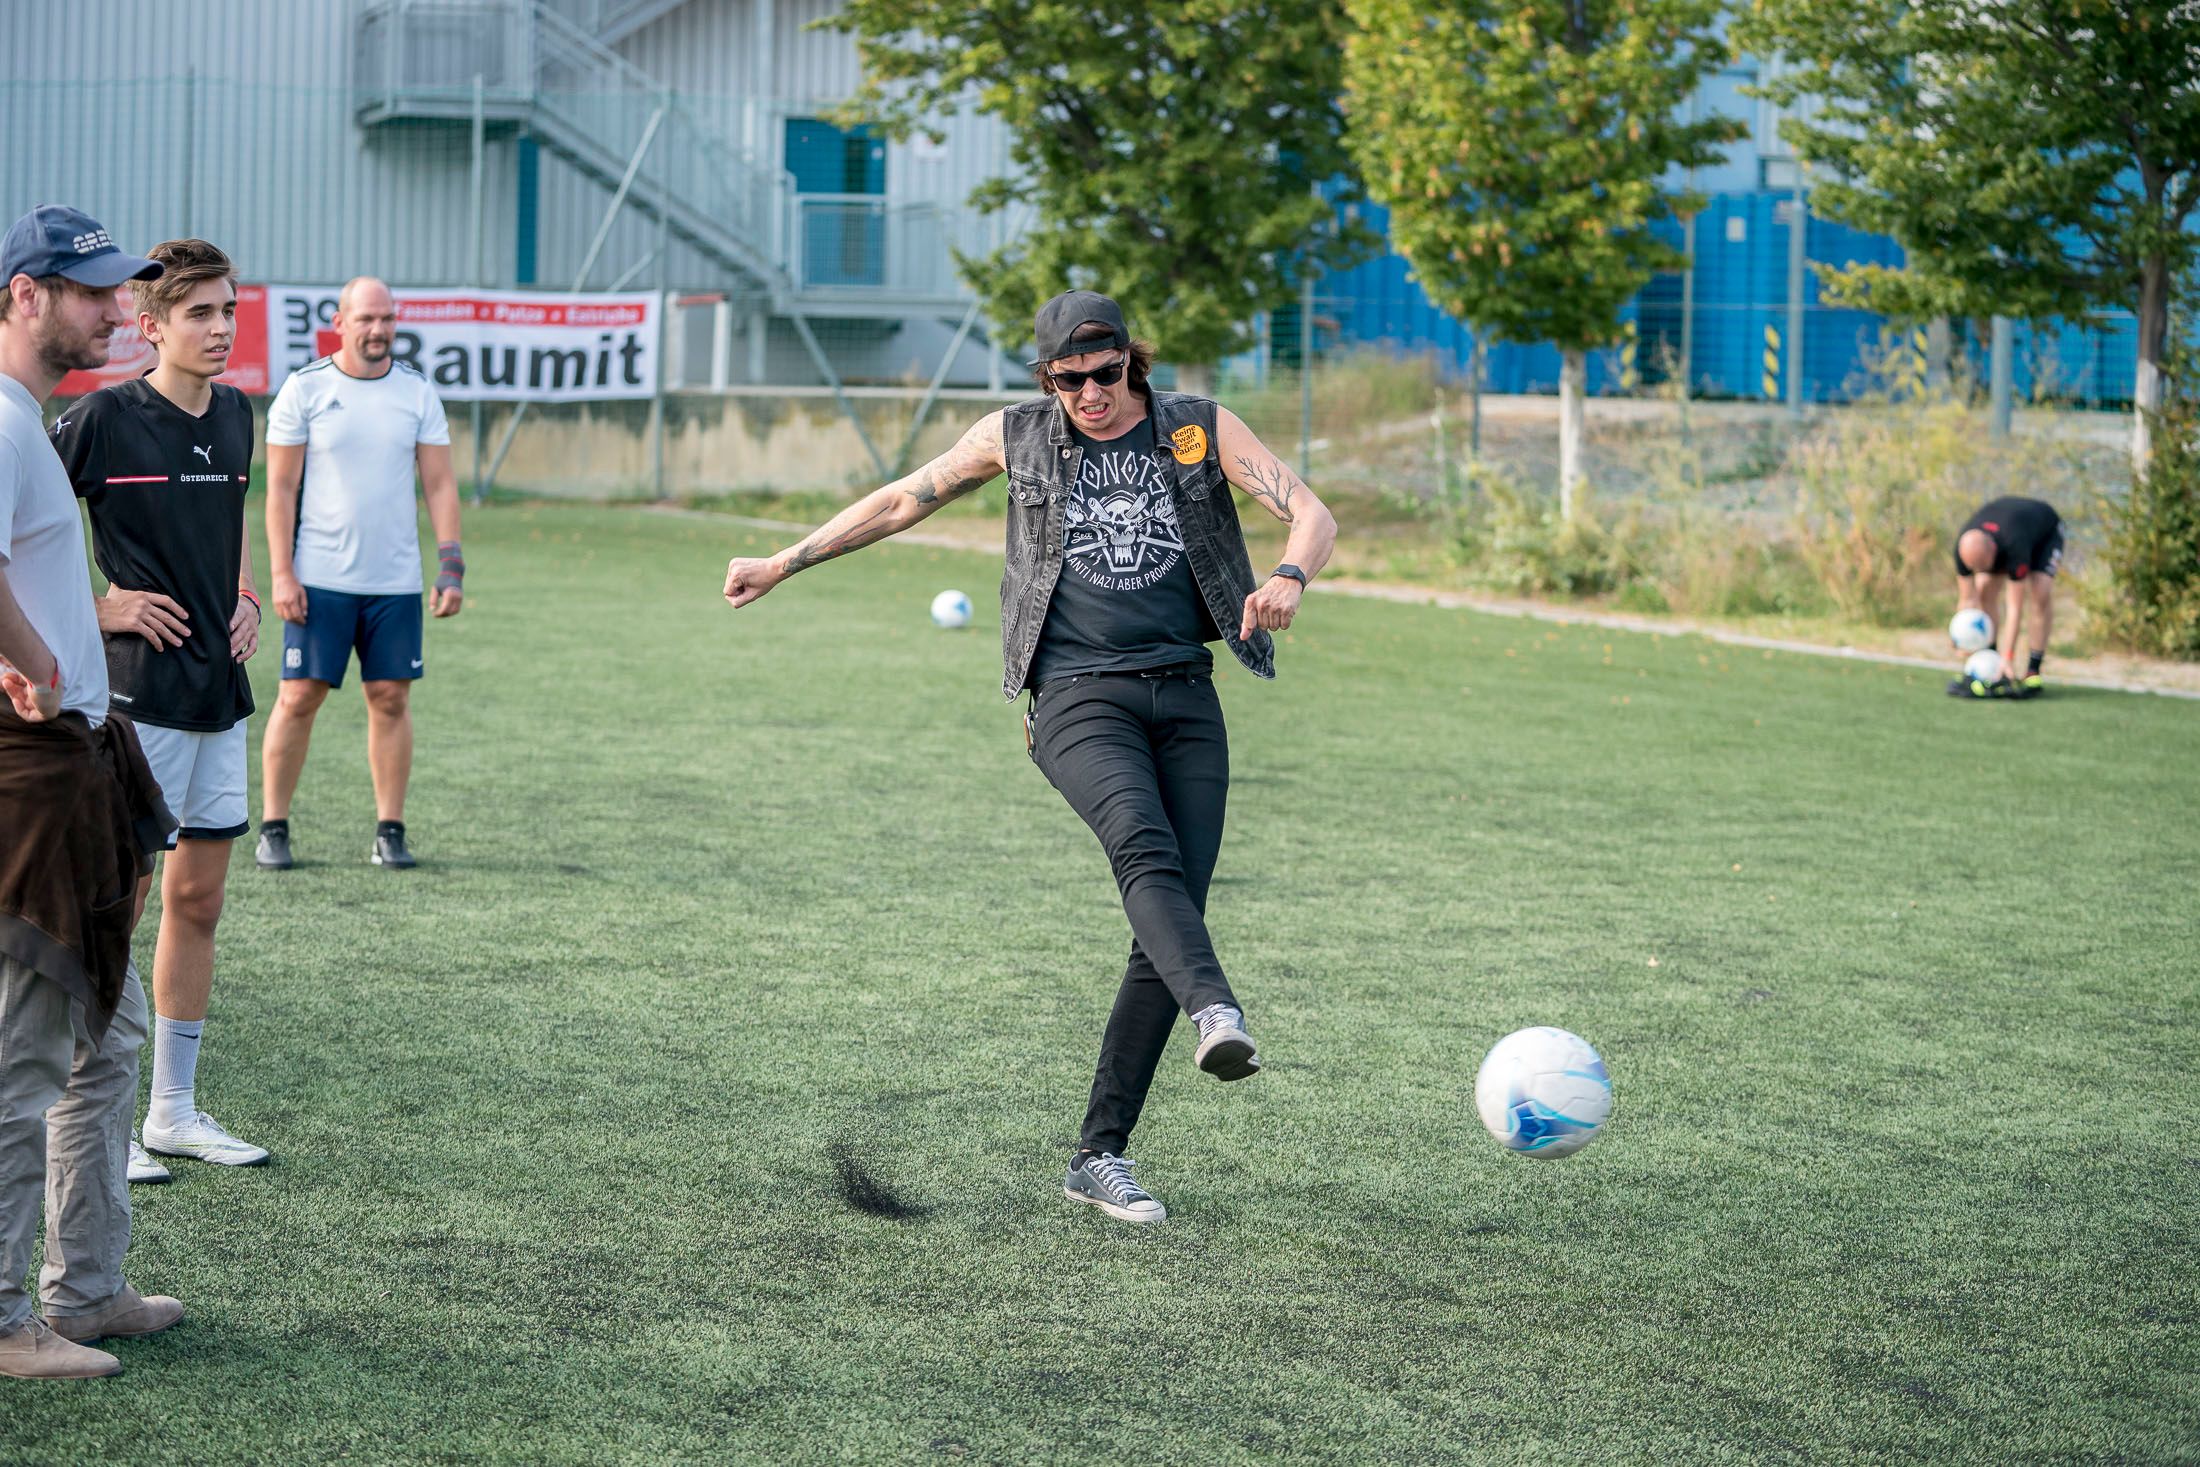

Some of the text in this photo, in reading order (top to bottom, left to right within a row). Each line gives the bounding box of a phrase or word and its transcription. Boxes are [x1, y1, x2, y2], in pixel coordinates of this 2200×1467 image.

[394, 331, 642, 388] Baumit
[1174, 431, 1197, 445] ewalt
[1177, 438, 1195, 448] egen
[1174, 442, 1201, 456] rauen
[180, 473, 229, 482] ÖSTERREICH
[1067, 550, 1180, 591] ANTI NAZI ABER PROMILLE
